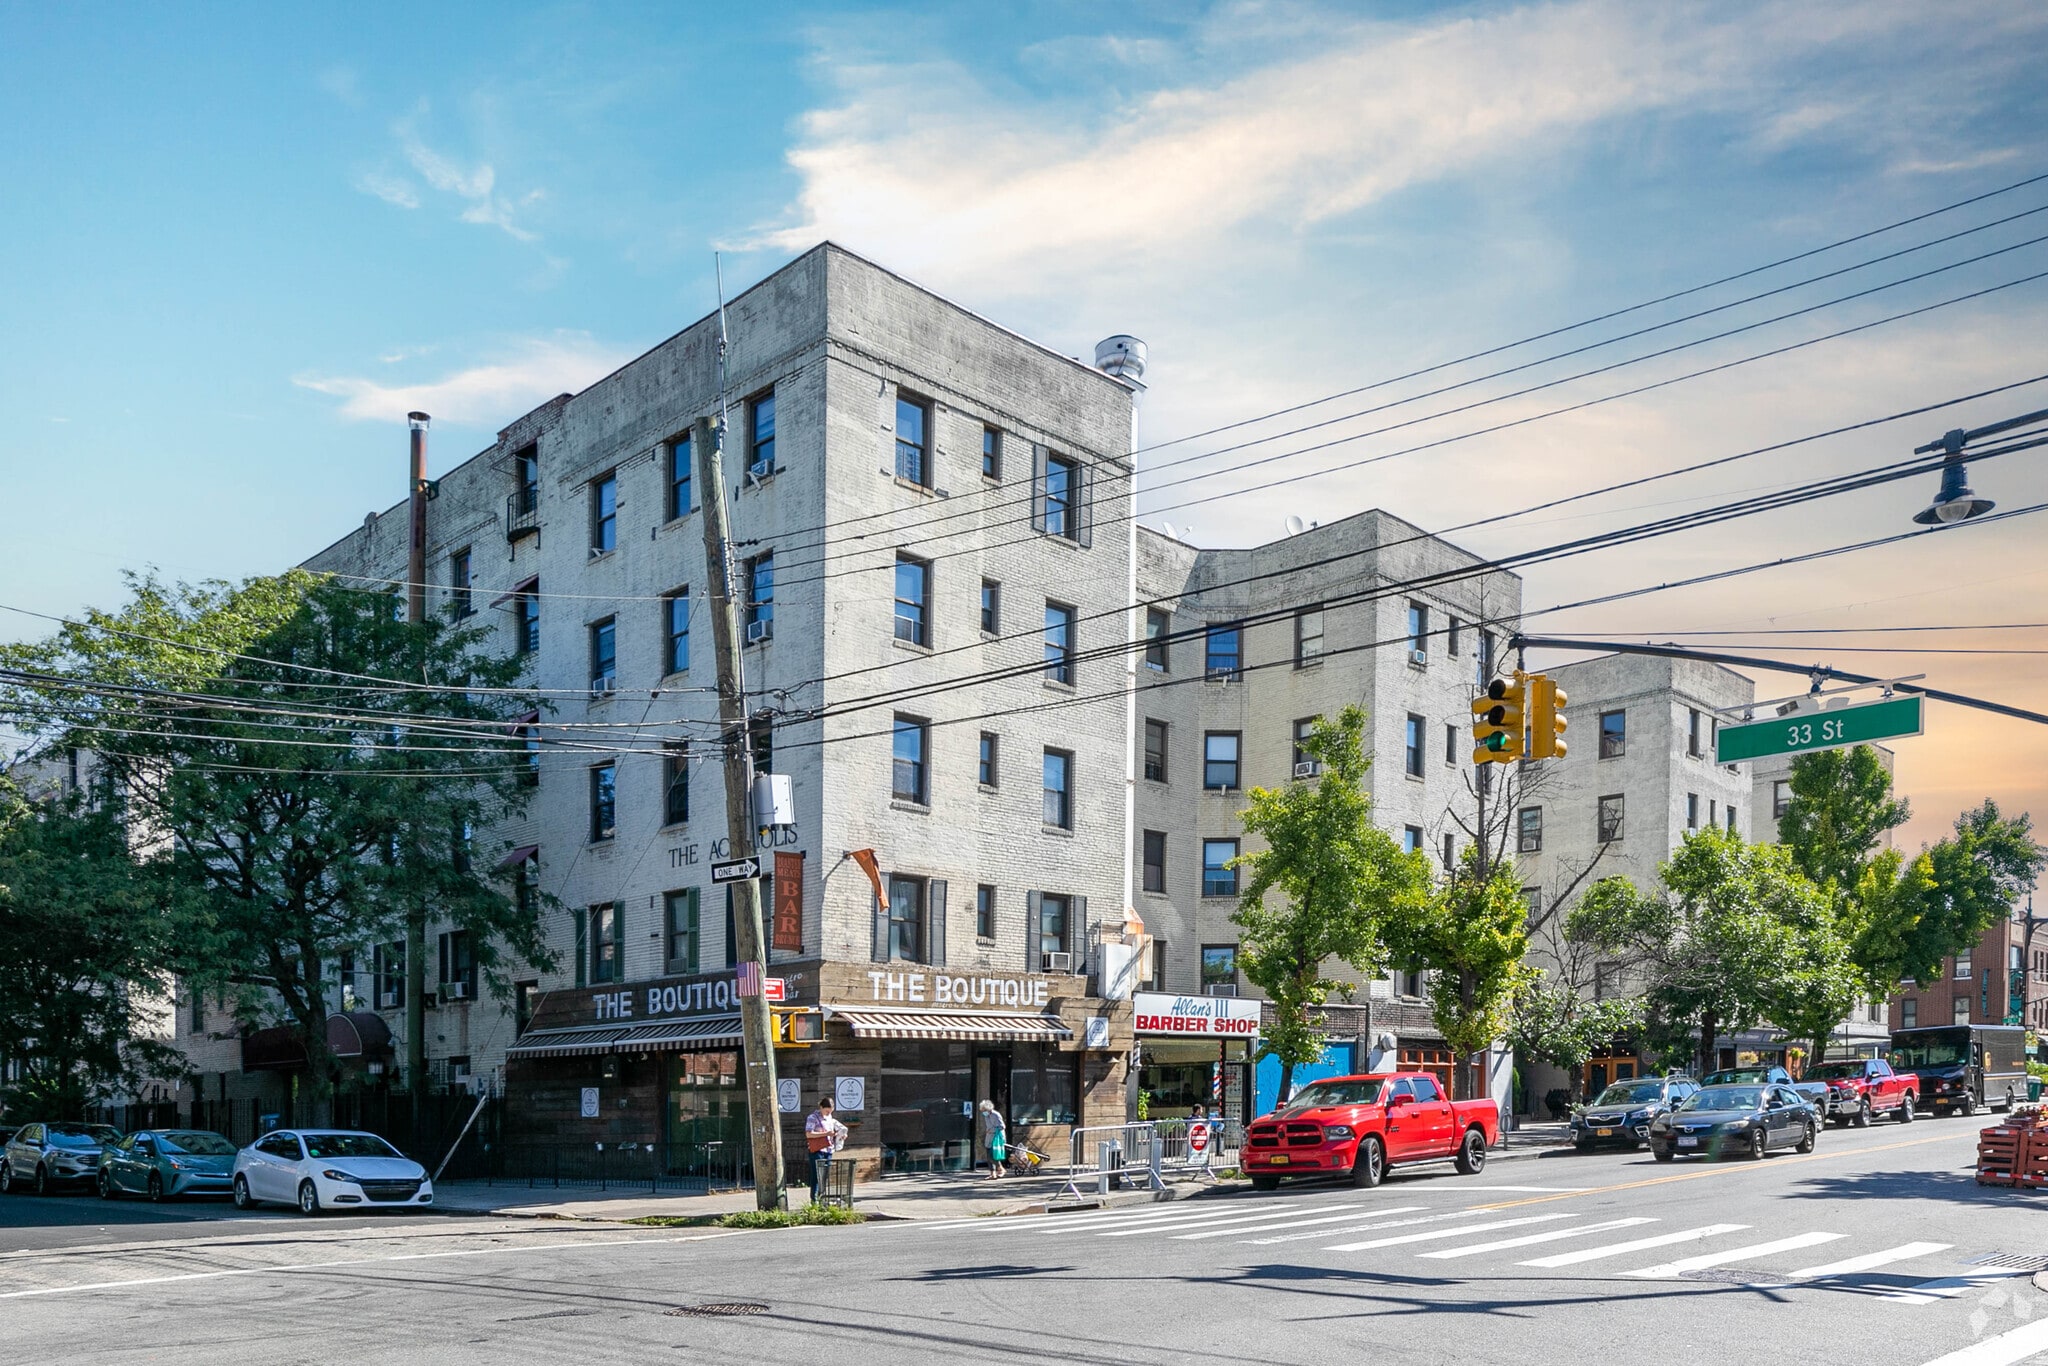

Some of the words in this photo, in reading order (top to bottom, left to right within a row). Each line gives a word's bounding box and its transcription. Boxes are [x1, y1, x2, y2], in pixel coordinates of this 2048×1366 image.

[1787, 724, 1812, 746] 33
[1822, 720, 1844, 740] St
[668, 844, 698, 868] THE
[709, 823, 798, 860] ACOLIS
[718, 868, 732, 877] ONE
[738, 864, 753, 875] WAY
[780, 880, 799, 933] BAR
[593, 991, 632, 1019] THE
[648, 979, 742, 1015] BOUTIQU
[867, 971, 925, 1002] THE
[935, 975, 1048, 1008] BOUTIQUE
[1171, 997, 1212, 1017] Allan's
[1215, 999, 1229, 1017] III
[1136, 1015, 1208, 1032] BARBER
[1214, 1018, 1259, 1033] SHOP
[965, 1103, 971, 1111] A
